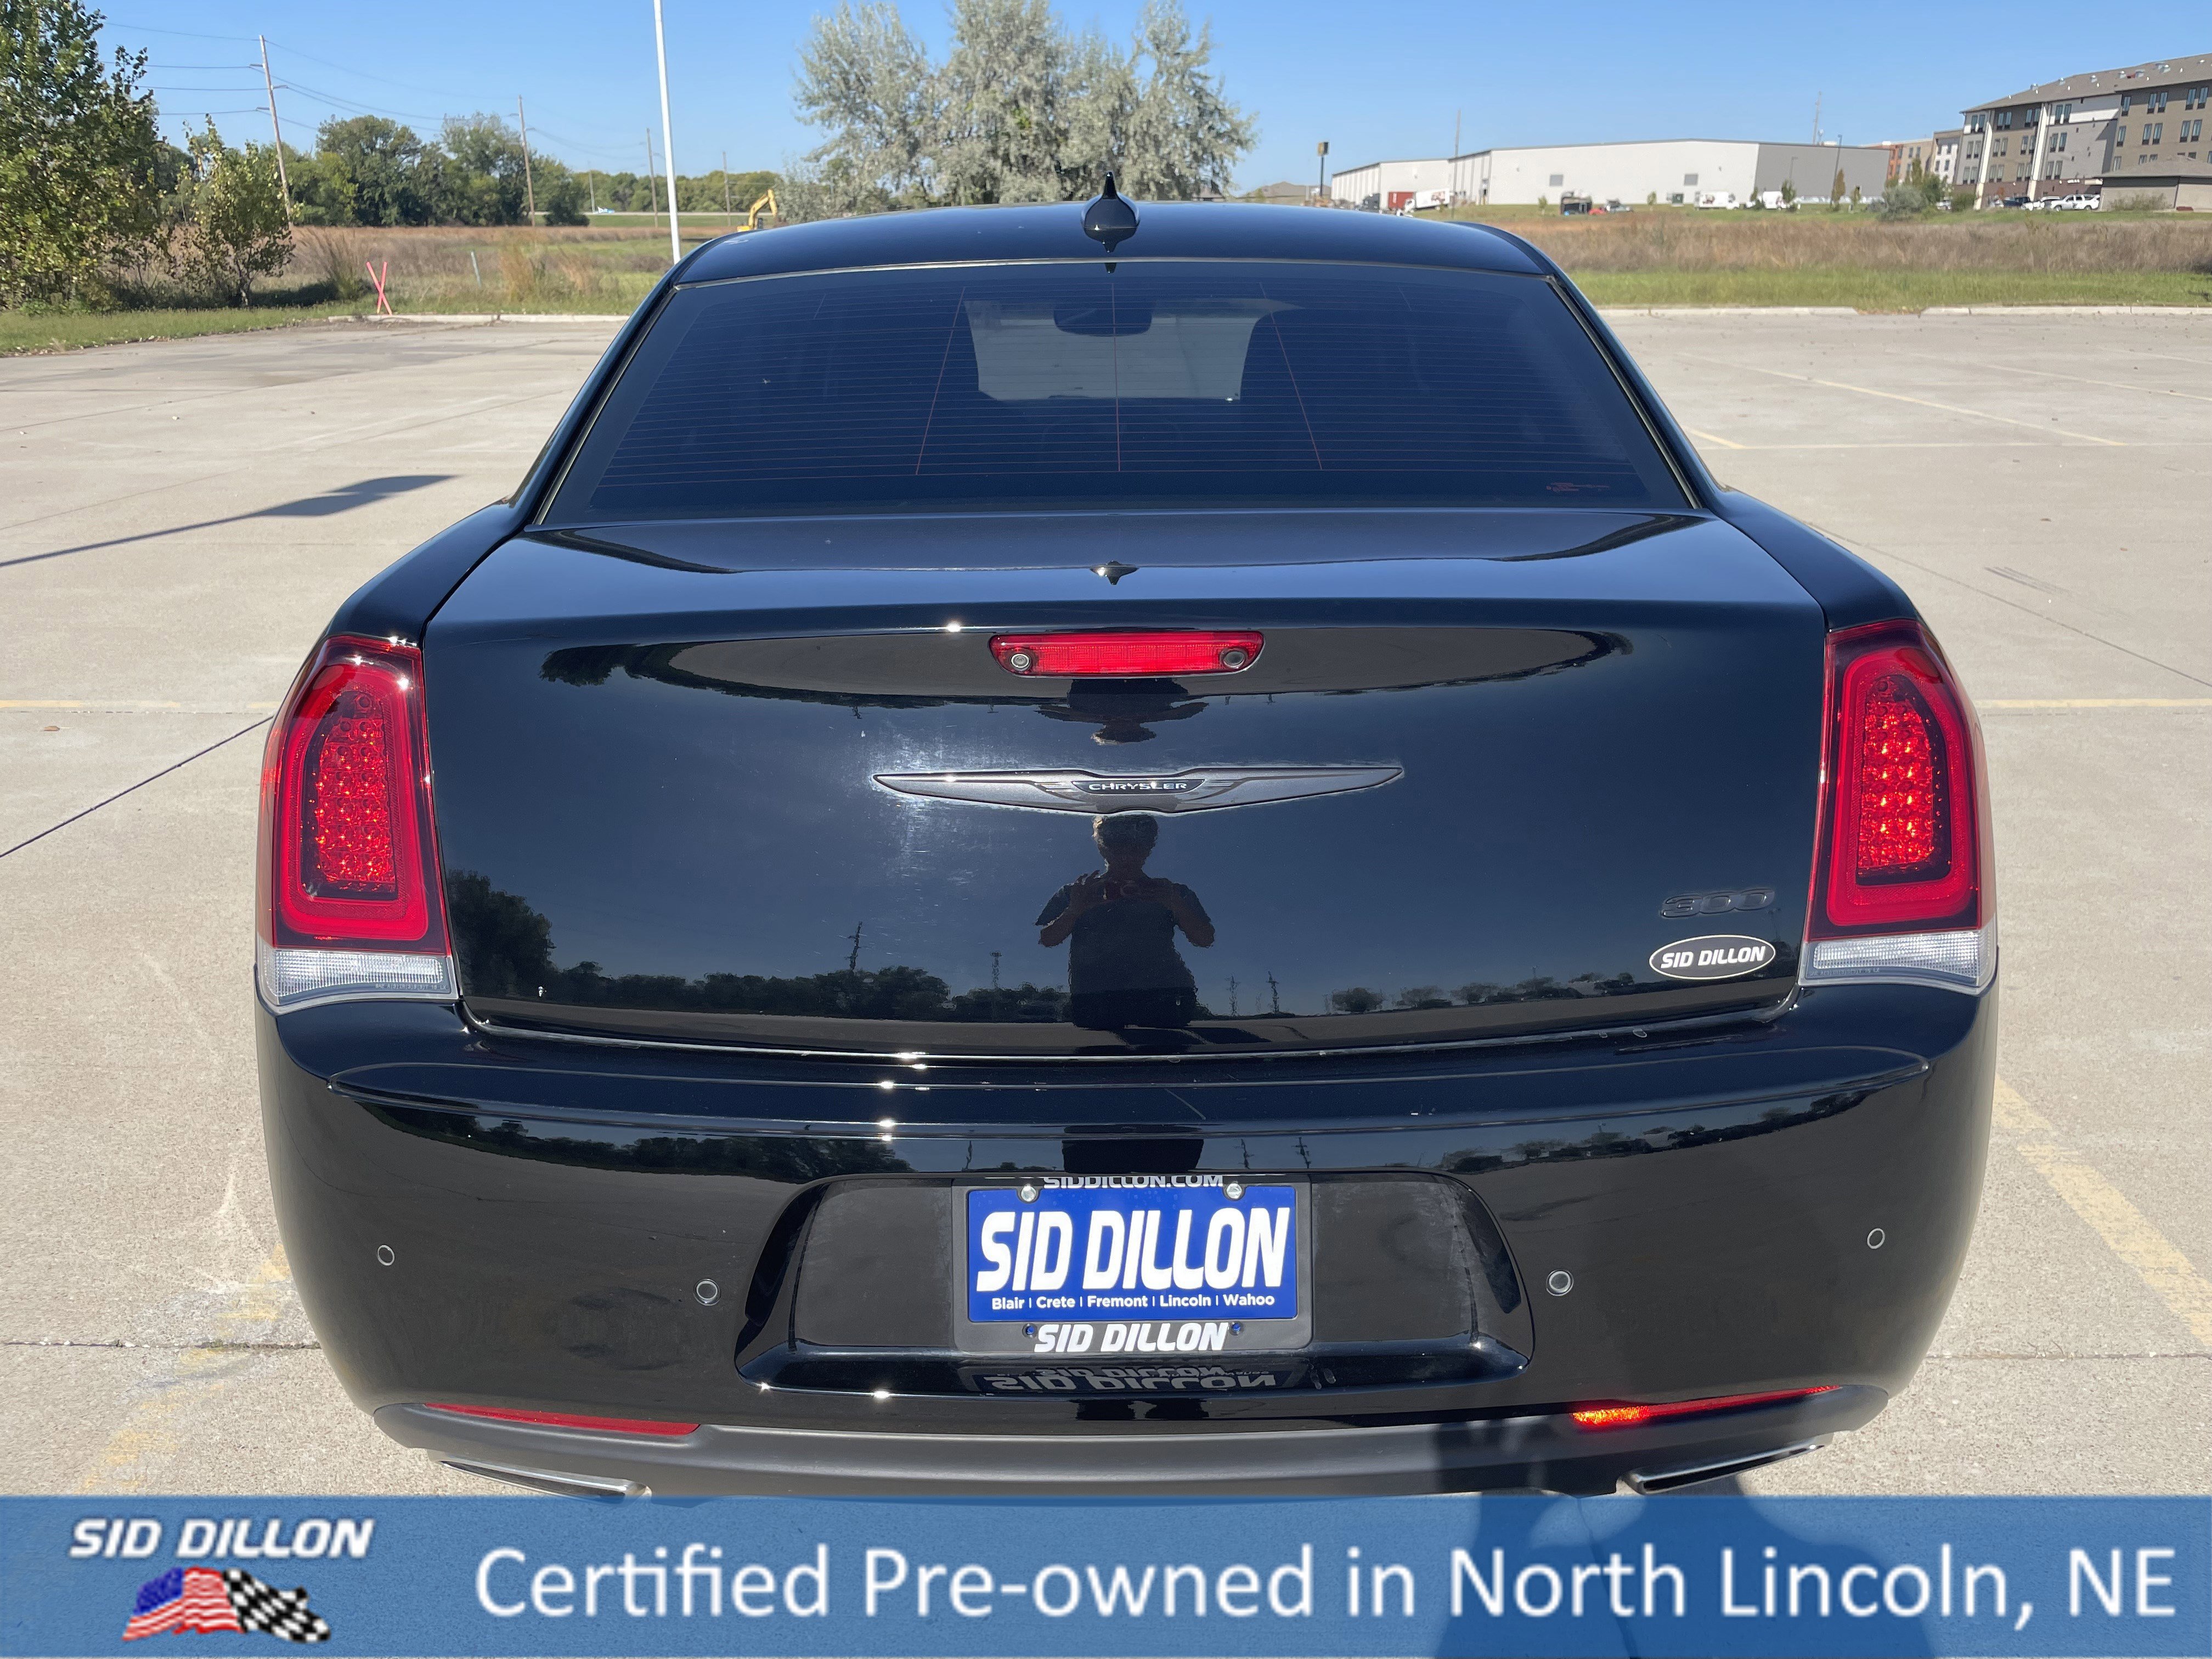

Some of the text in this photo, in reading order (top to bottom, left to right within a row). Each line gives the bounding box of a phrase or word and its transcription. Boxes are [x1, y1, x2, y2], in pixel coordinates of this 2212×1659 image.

[1088, 782, 1187, 791] CHRYSLER
[1661, 888, 1775, 918] 300
[1660, 945, 1766, 969] SID DILLON
[1043, 1175, 1223, 1188] SIDDILLON.COM
[976, 1207, 1290, 1291] SID DILLON
[992, 1293, 1275, 1310] Blair Crete Fremont Lincoln Wahoo
[1034, 1322, 1229, 1352] SID DILLON
